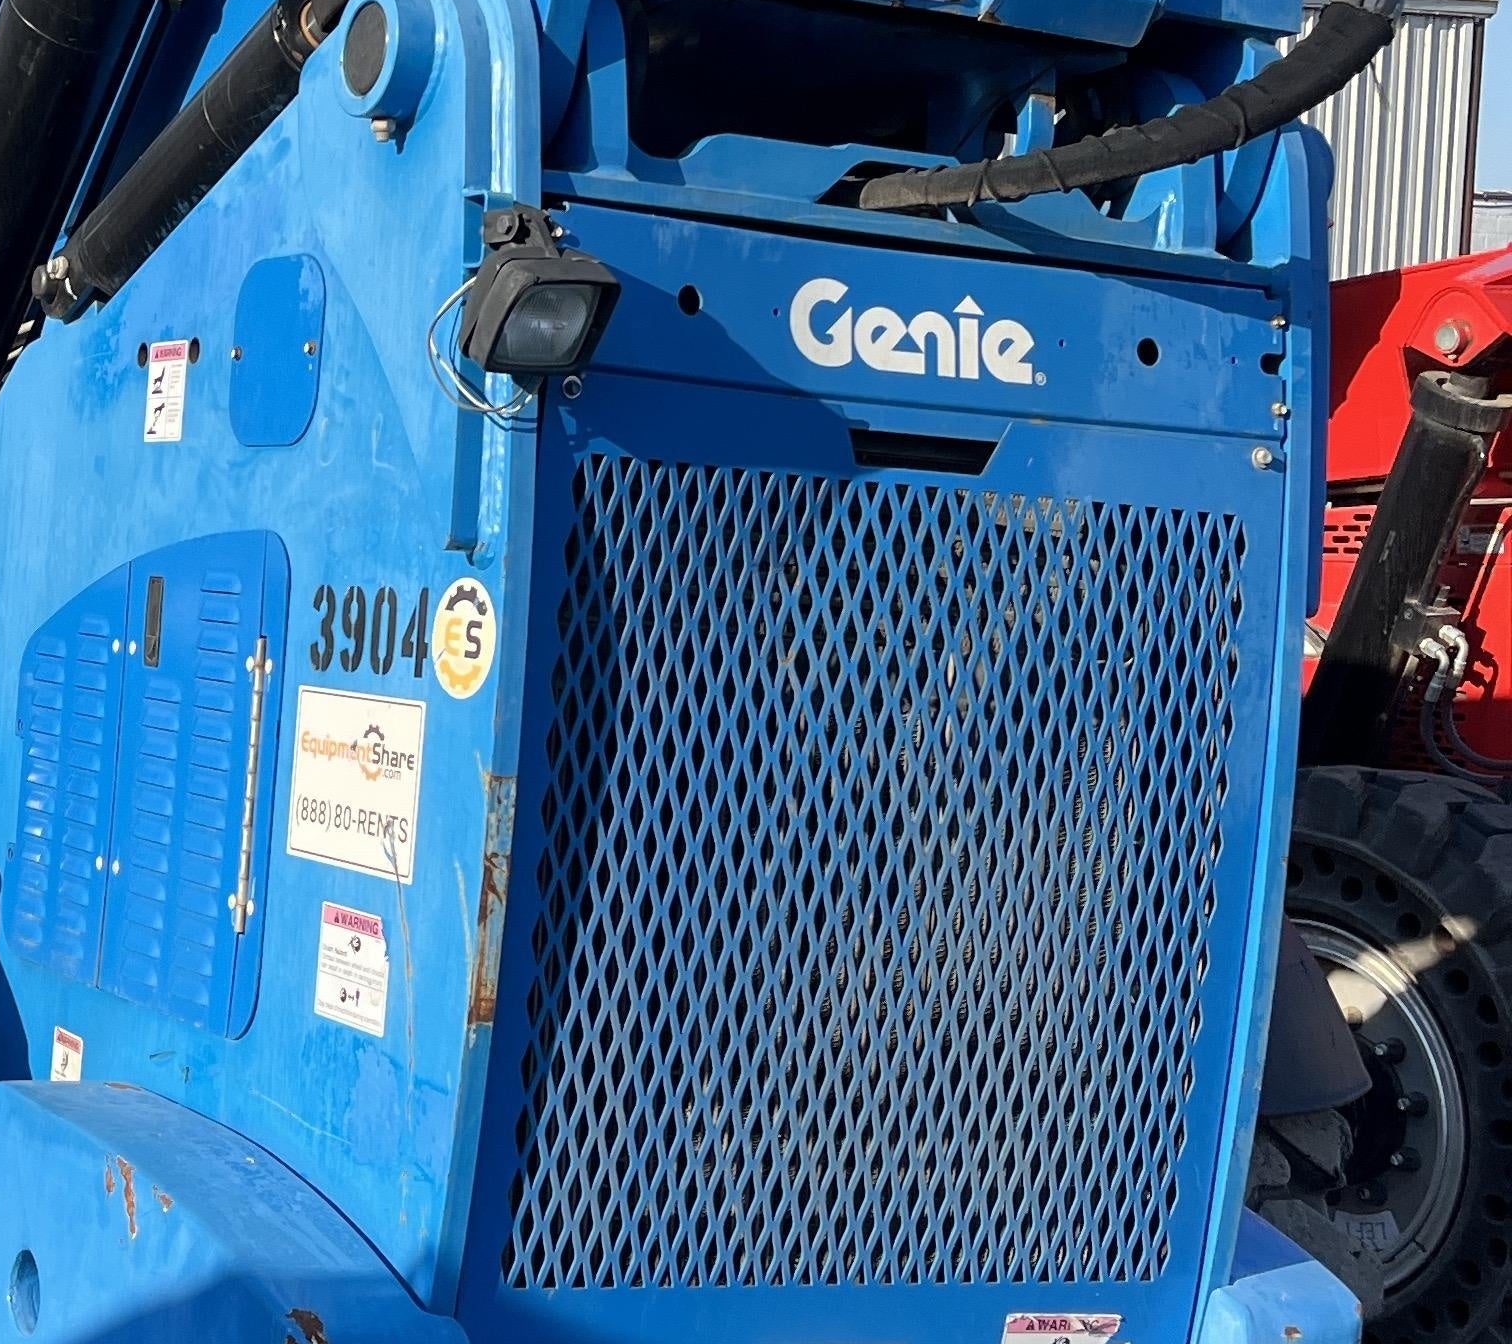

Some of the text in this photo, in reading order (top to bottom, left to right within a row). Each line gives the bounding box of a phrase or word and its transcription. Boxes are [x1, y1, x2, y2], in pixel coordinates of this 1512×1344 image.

[790, 277, 1036, 386] Genie
[309, 584, 432, 679] 3904
[444, 617, 483, 660] ES
[341, 911, 379, 936] WARNING
